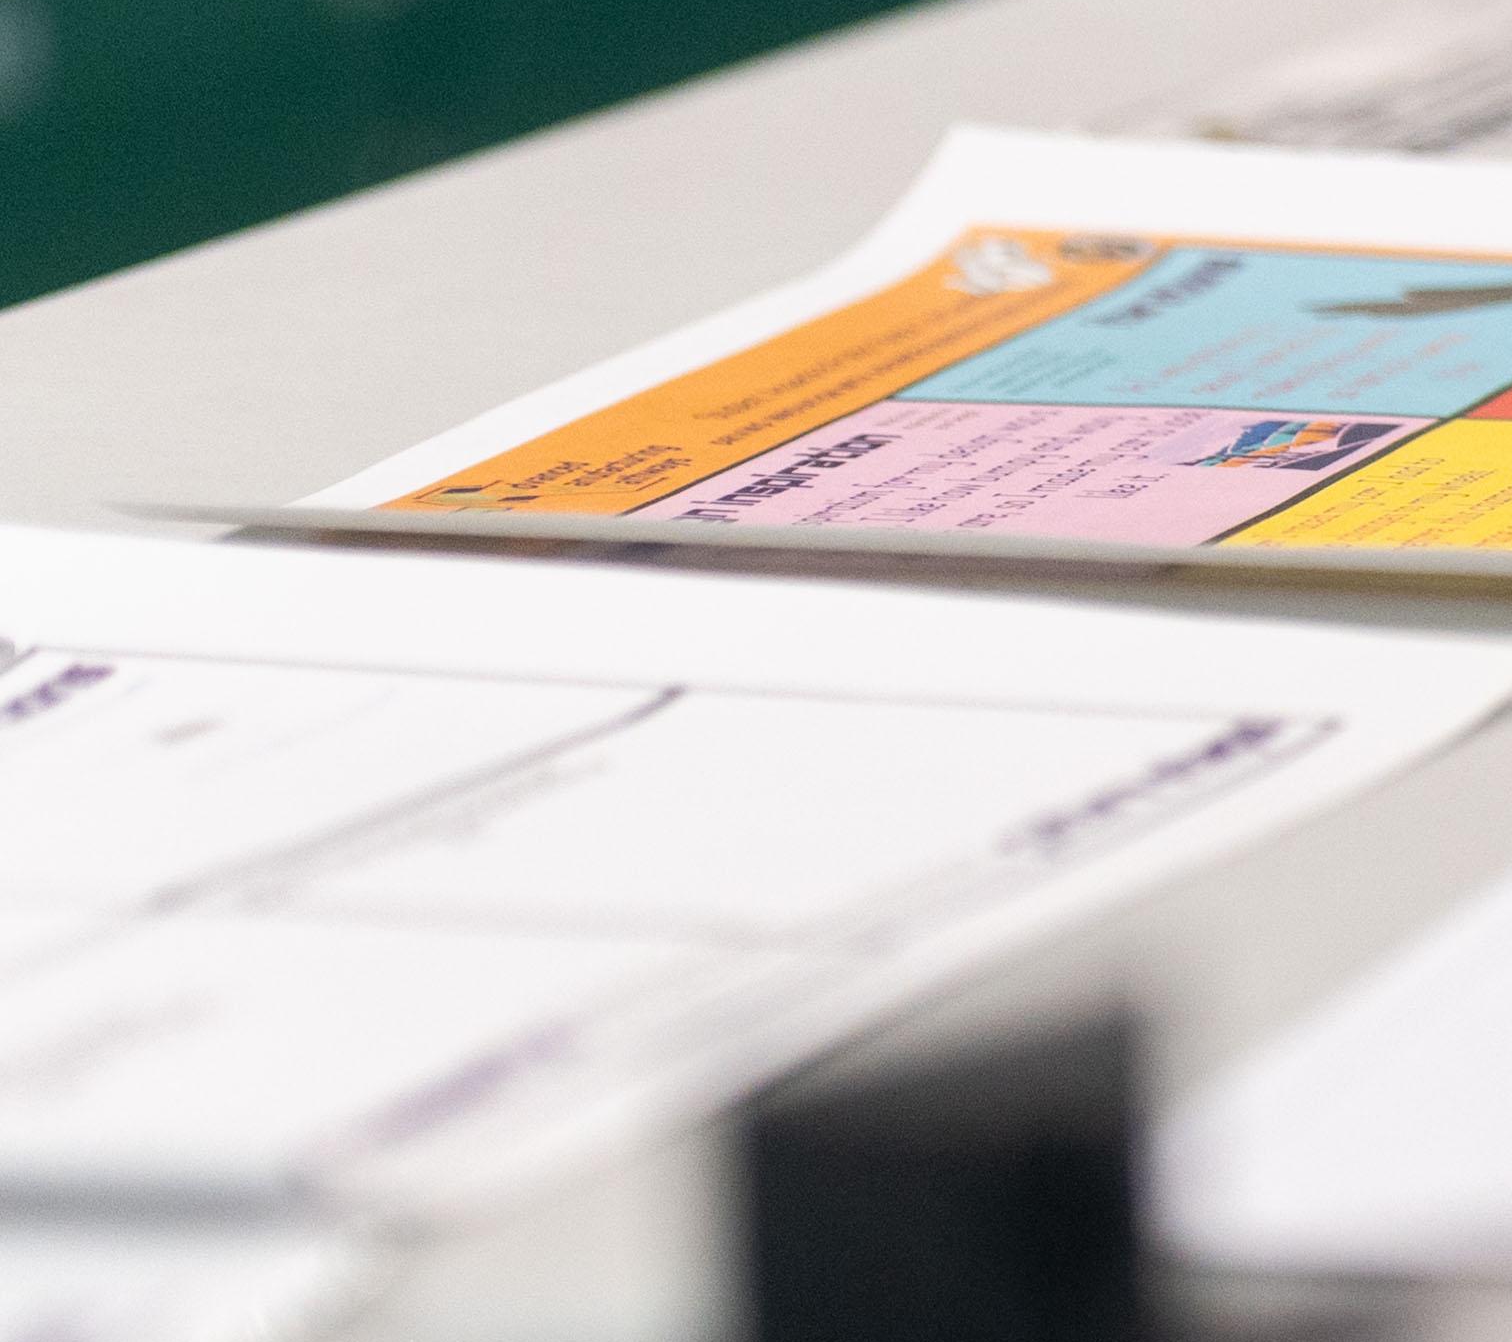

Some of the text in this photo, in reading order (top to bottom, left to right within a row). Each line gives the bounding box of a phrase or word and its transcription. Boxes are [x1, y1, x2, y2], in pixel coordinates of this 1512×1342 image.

[923, 432, 1025, 460] design
[1017, 435, 1084, 453] and
[1107, 436, 1153, 452] car
[902, 460, 978, 476] my
[944, 453, 1071, 483] bumpy
[1074, 452, 1151, 468] my
[690, 433, 901, 507] inspiration
[850, 474, 928, 491] for
[1025, 467, 1098, 493] made
[1075, 472, 1171, 499] like it.
[905, 482, 987, 502] how
[1406, 491, 1472, 505] my
[788, 489, 894, 526] spiration
[879, 501, 949, 517] like
[992, 499, 1036, 510] so
